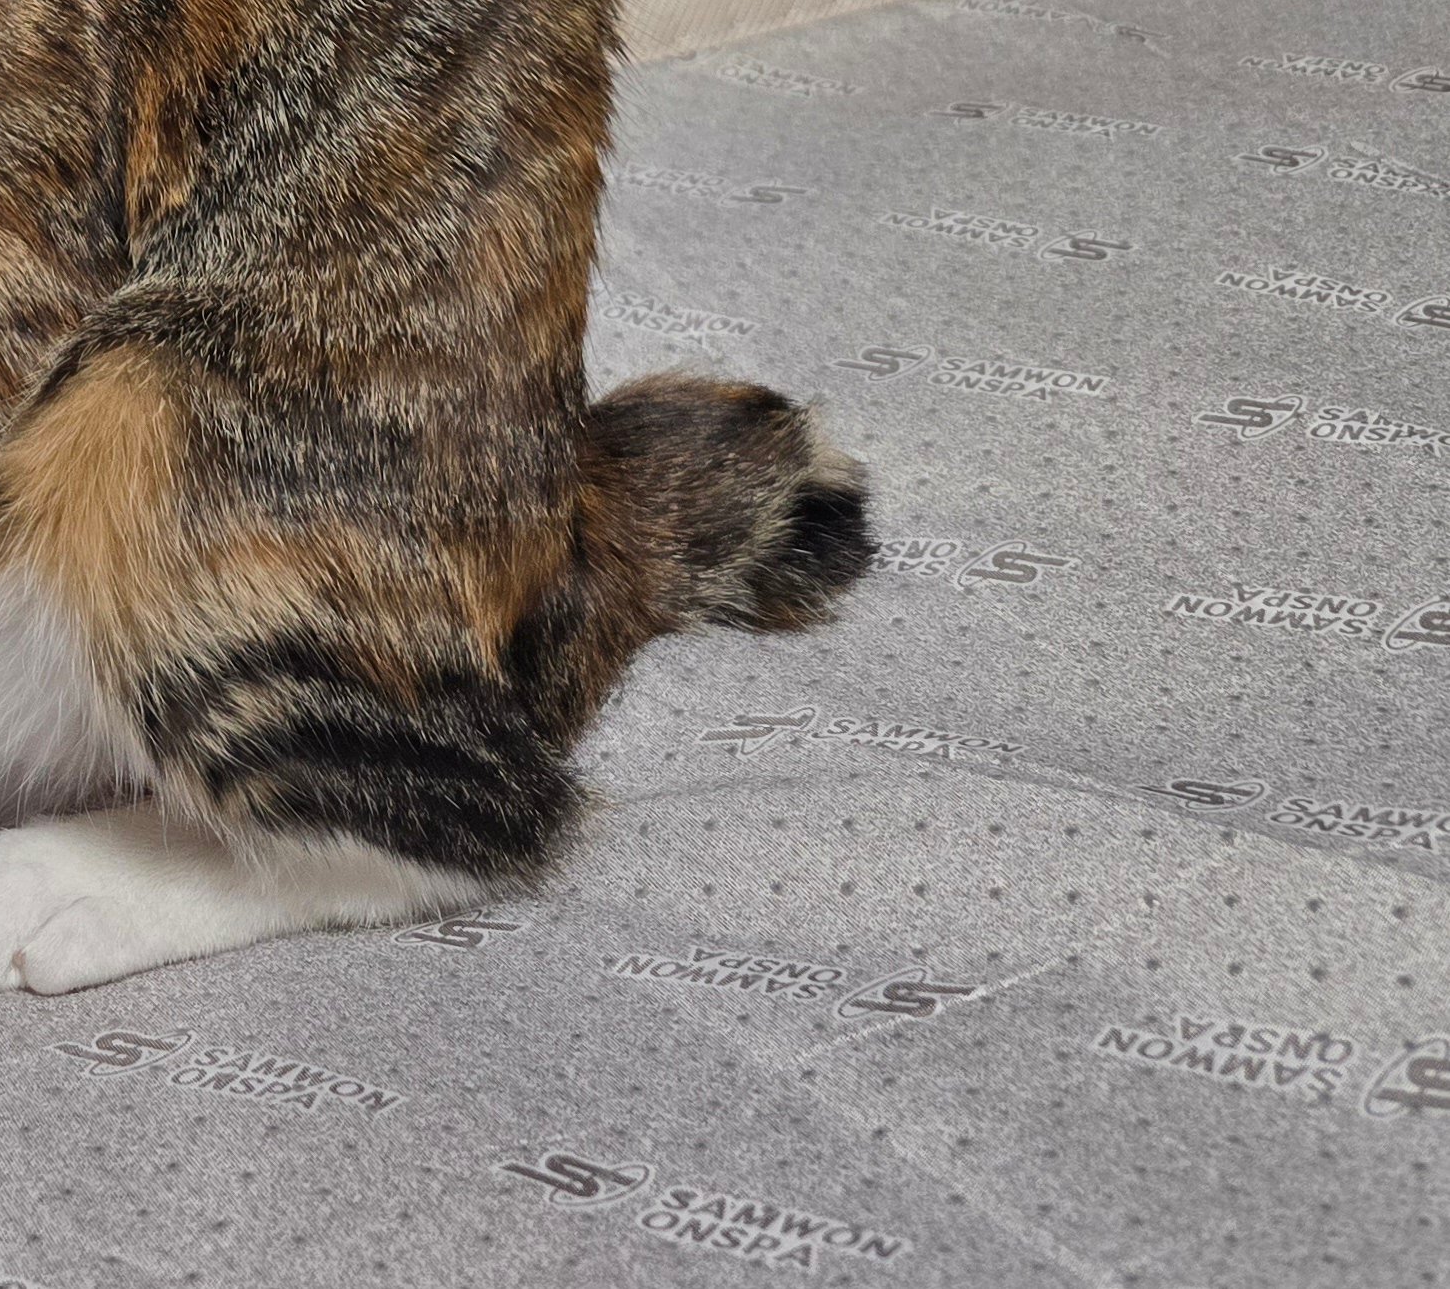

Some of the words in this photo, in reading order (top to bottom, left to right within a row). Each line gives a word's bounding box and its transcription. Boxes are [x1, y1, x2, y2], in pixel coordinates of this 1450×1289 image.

[886, 214, 1028, 247] SAMWON
[933, 210, 1038, 237] ONSPA
[1220, 273, 1378, 312] SAMWON
[1272, 269, 1387, 303] ONSPA
[930, 373, 1050, 401] ONSPA
[940, 358, 1104, 393] SAMWON
[1172, 596, 1370, 635] SAMWON
[1234, 585, 1380, 617] ONSPA
[1270, 811, 1434, 850] ONSPA
[617, 955, 825, 1001] SAMWON
[693, 947, 844, 983] ONSPA
[1179, 1015, 1353, 1065] ONSPA
[193, 1045, 400, 1113] SAMWON
[1099, 1027, 1343, 1095] SAMWON
[170, 1065, 320, 1111] ONSPA
[642, 1208, 818, 1268] ONSPA
[661, 1186, 903, 1261] SAMWON
